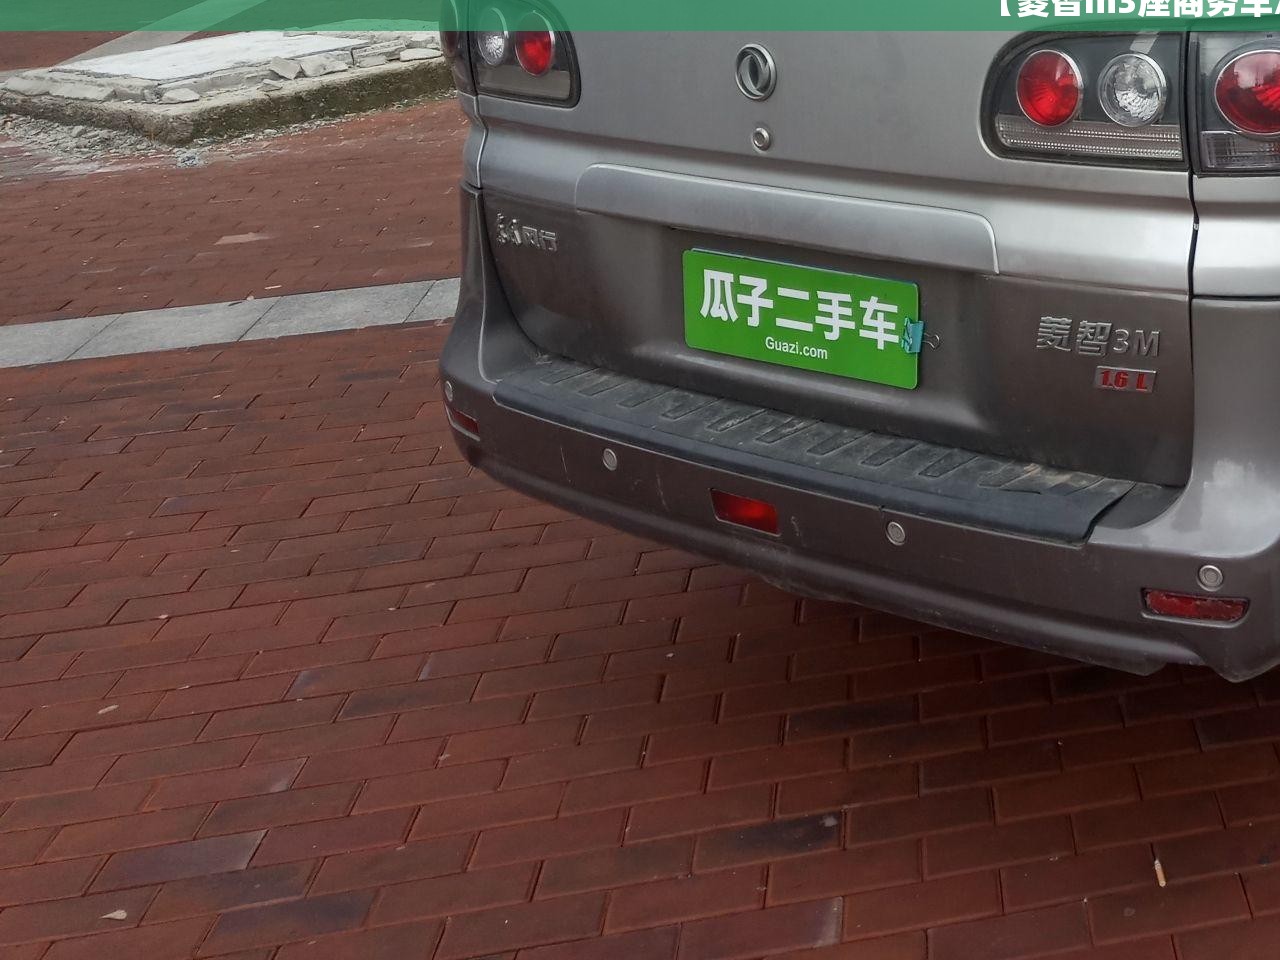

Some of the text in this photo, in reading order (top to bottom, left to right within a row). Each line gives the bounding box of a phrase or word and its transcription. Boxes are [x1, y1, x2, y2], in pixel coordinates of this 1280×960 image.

[700, 269, 900, 350] 瓜子二手车
[765, 336, 828, 360] Guazi.com
